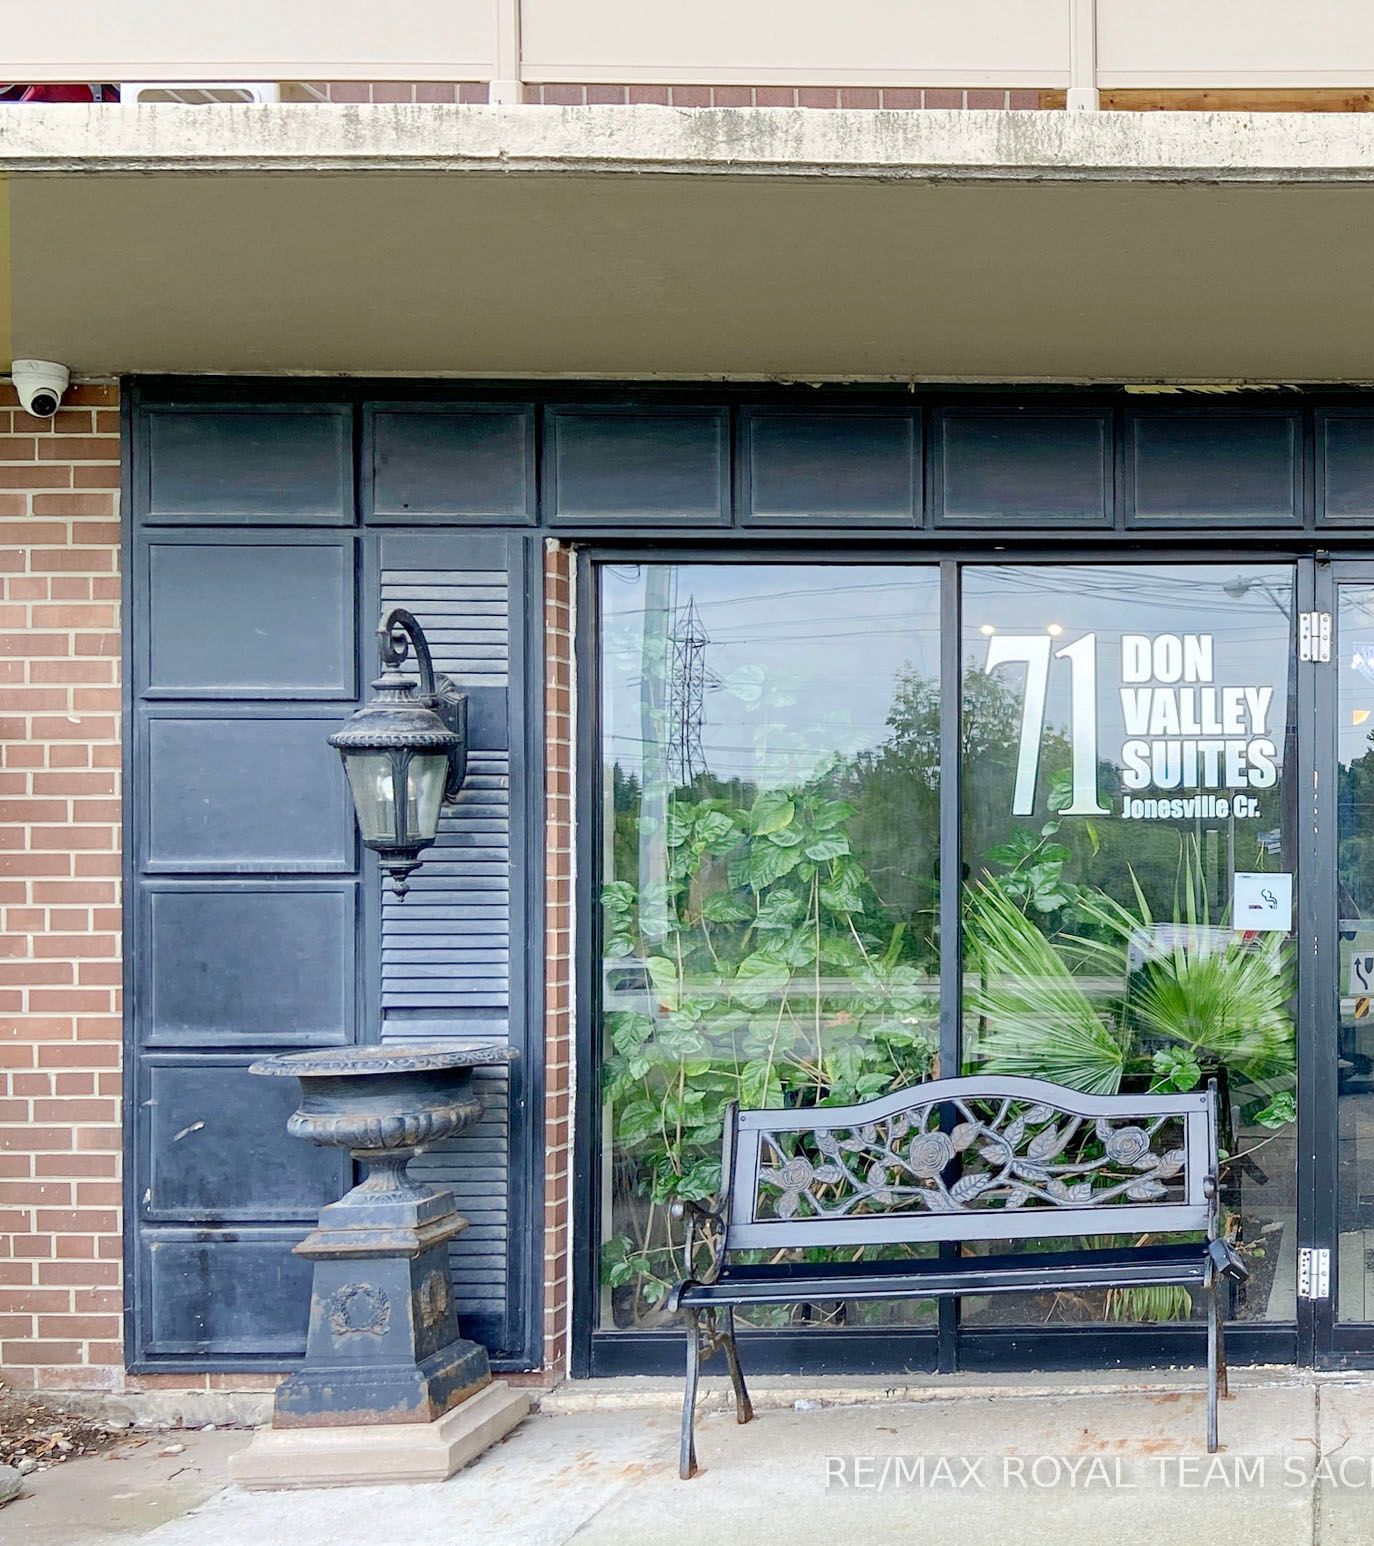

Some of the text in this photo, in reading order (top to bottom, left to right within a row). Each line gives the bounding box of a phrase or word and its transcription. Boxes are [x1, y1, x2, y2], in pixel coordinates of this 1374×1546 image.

[1120, 633, 1214, 684] DON
[984, 632, 1111, 817] 71
[1119, 686, 1274, 736] VALLEY
[1121, 738, 1278, 790] SUITES
[1121, 794, 1262, 819] Jonesville Cr.
